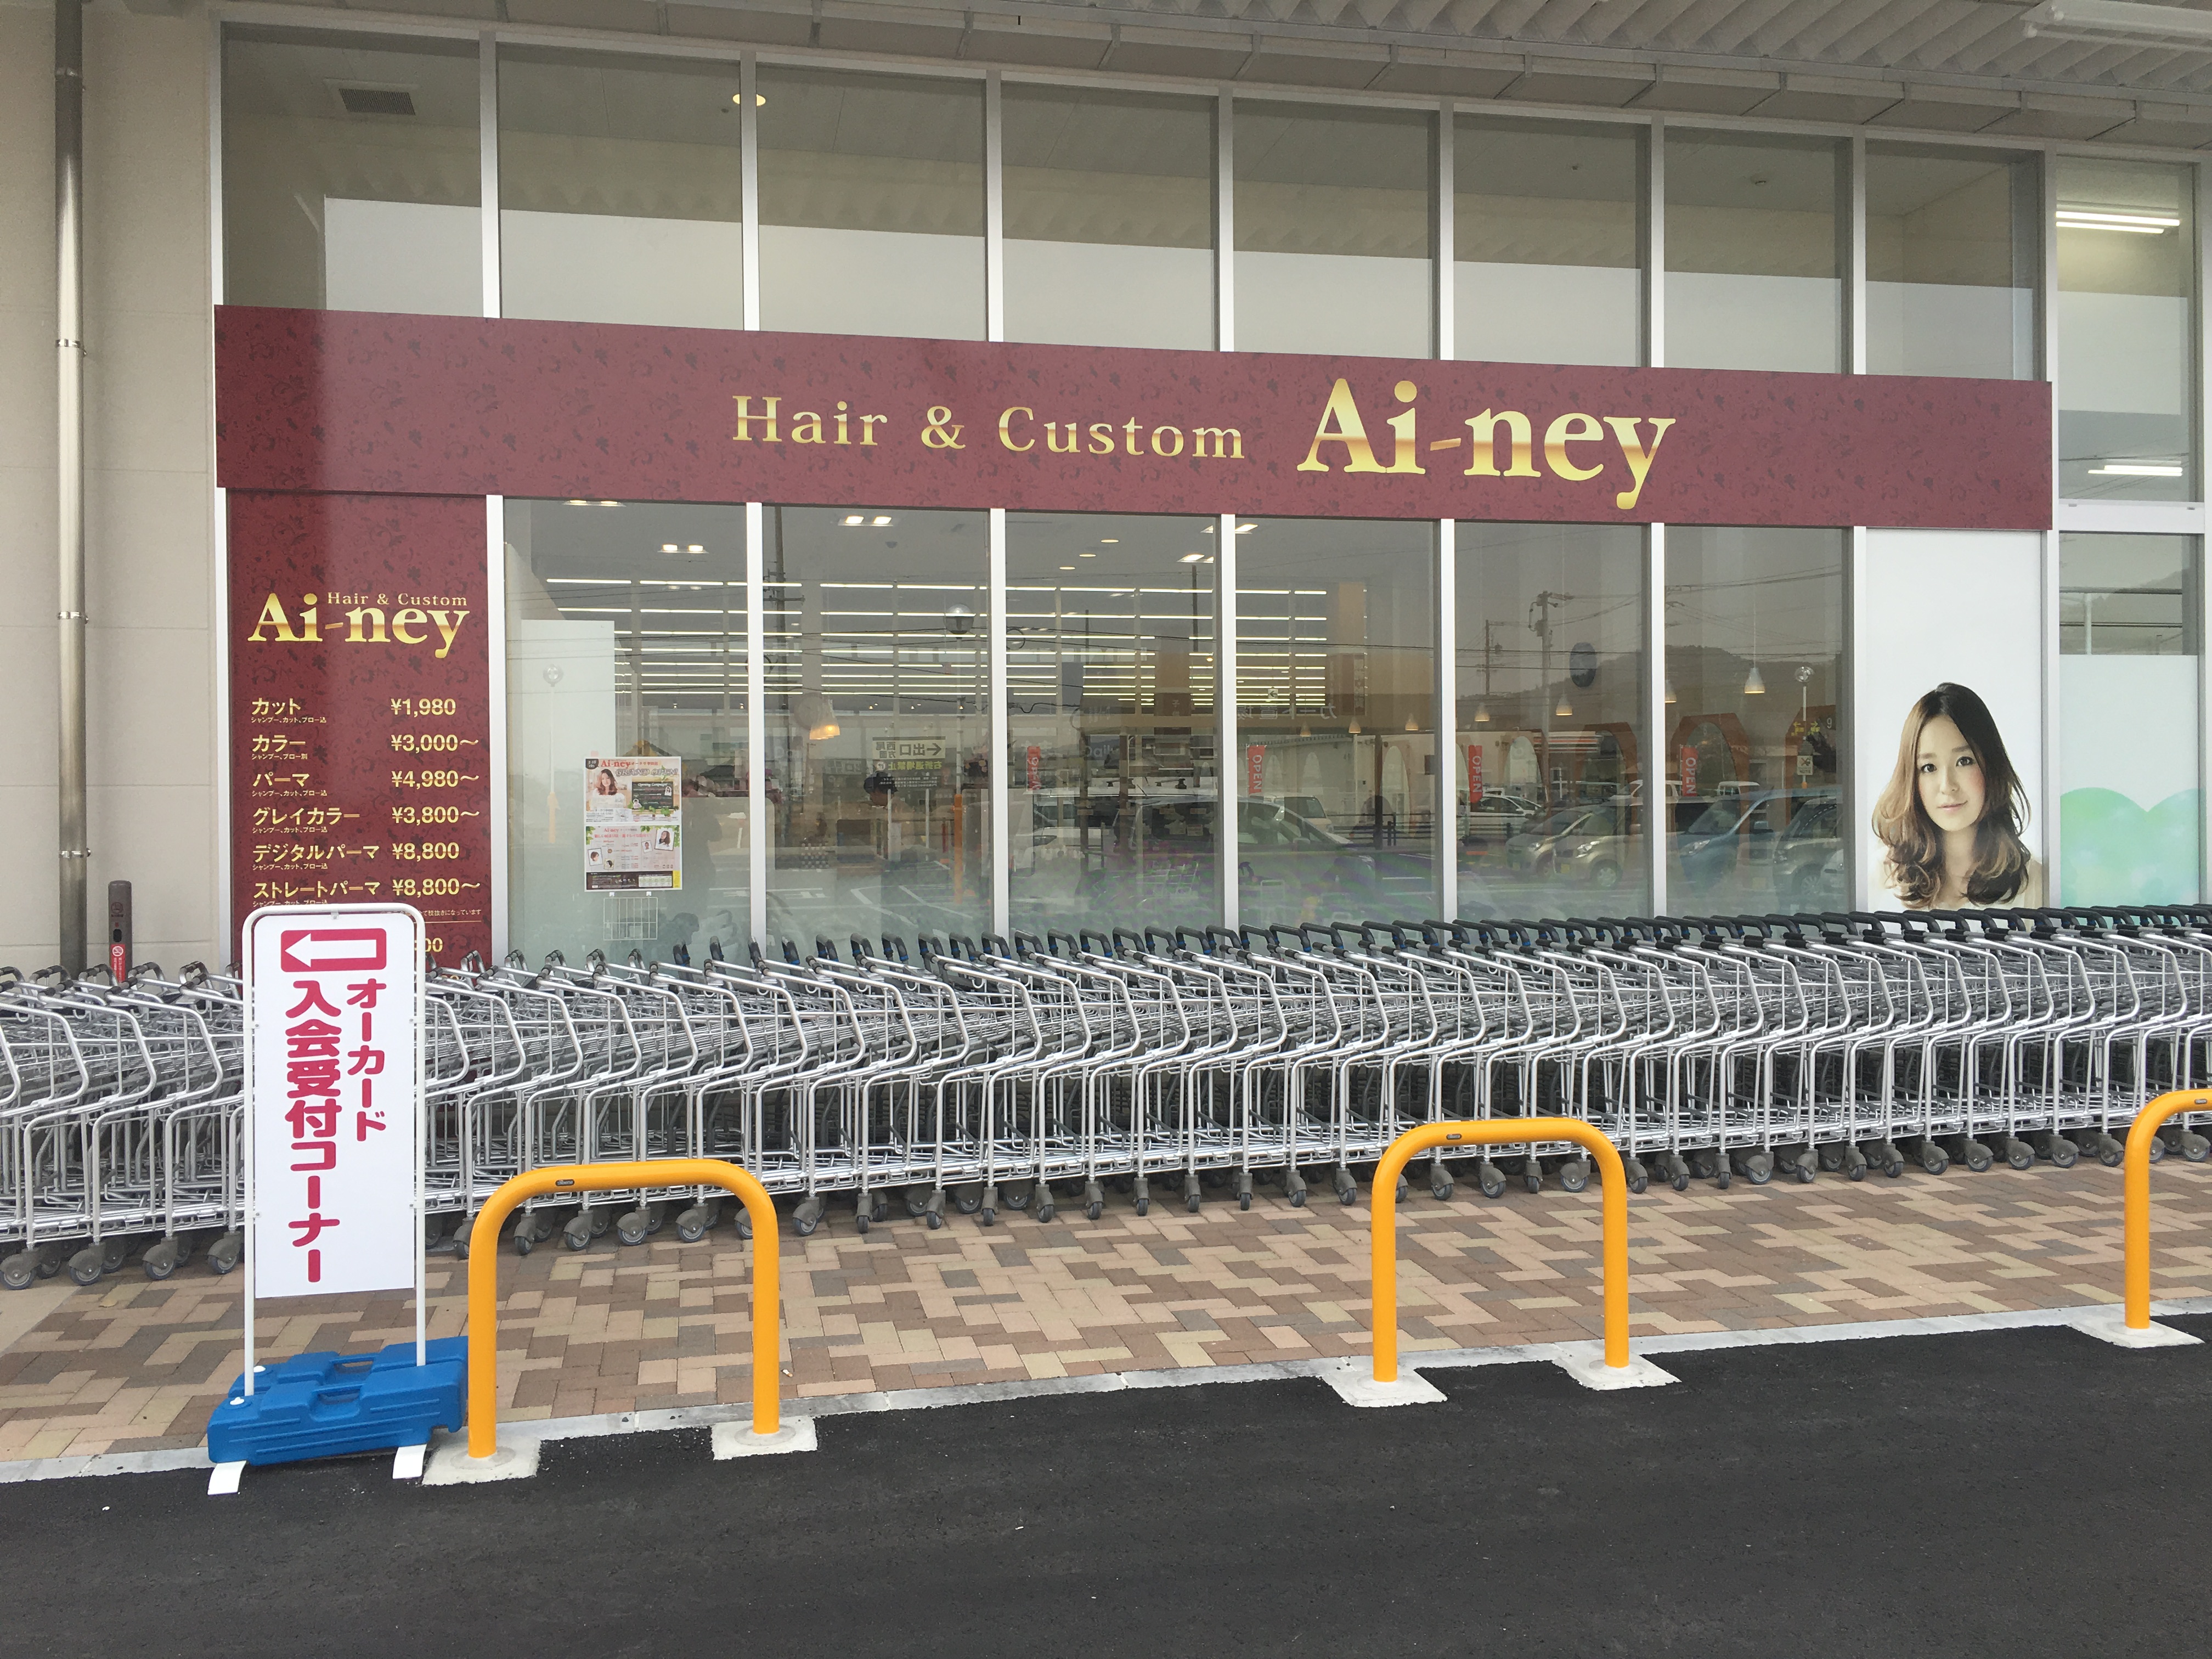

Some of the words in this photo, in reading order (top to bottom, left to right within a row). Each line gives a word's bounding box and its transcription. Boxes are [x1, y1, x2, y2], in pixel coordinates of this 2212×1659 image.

[732, 396, 887, 445] Hair
[921, 406, 966, 449] &
[999, 407, 1244, 459] Custom
[1297, 379, 1676, 509] Ai-ney
[328, 592, 368, 605] Hair
[377, 593, 389, 605] &
[398, 593, 467, 606] Custom
[248, 593, 470, 658] Ai-ney
[252, 698, 301, 715] カット
[391, 698, 456, 718] ¥1,980
[252, 735, 306, 752] カラー
[253, 772, 309, 787] パーマ
[1252, 754, 1262, 790] OPEN
[1471, 755, 1482, 793] OPEN
[1685, 757, 1697, 794] OPEN
[253, 807, 359, 825] グレイカラー
[253, 844, 380, 863] デジタルパーマ
[392, 842, 459, 861] ¥8,800
[253, 881, 381, 899] ストレートパーマ
[348, 979, 386, 1141] オーカード
[286, 981, 342, 1282] 入会受付コーナー
